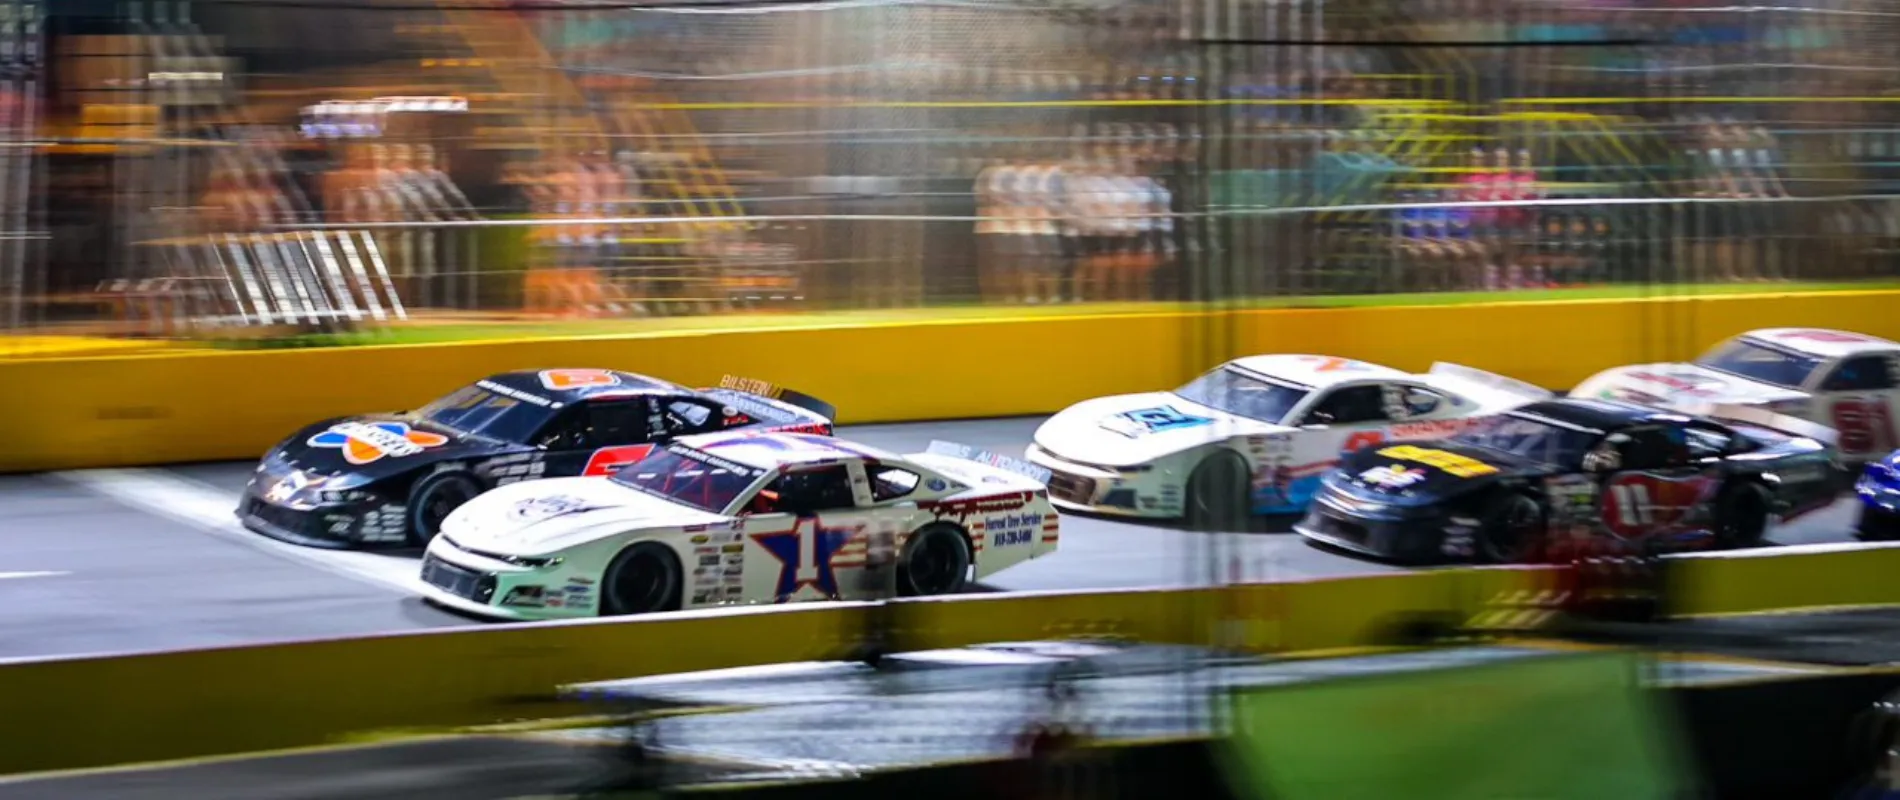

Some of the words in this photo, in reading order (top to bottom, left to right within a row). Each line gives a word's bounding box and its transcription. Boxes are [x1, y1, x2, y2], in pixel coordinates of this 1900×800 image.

[720, 373, 774, 398] BILSTEIN
[1021, 511, 1042, 527] Service
[1609, 484, 1653, 526] 11
[796, 519, 819, 581] 1
